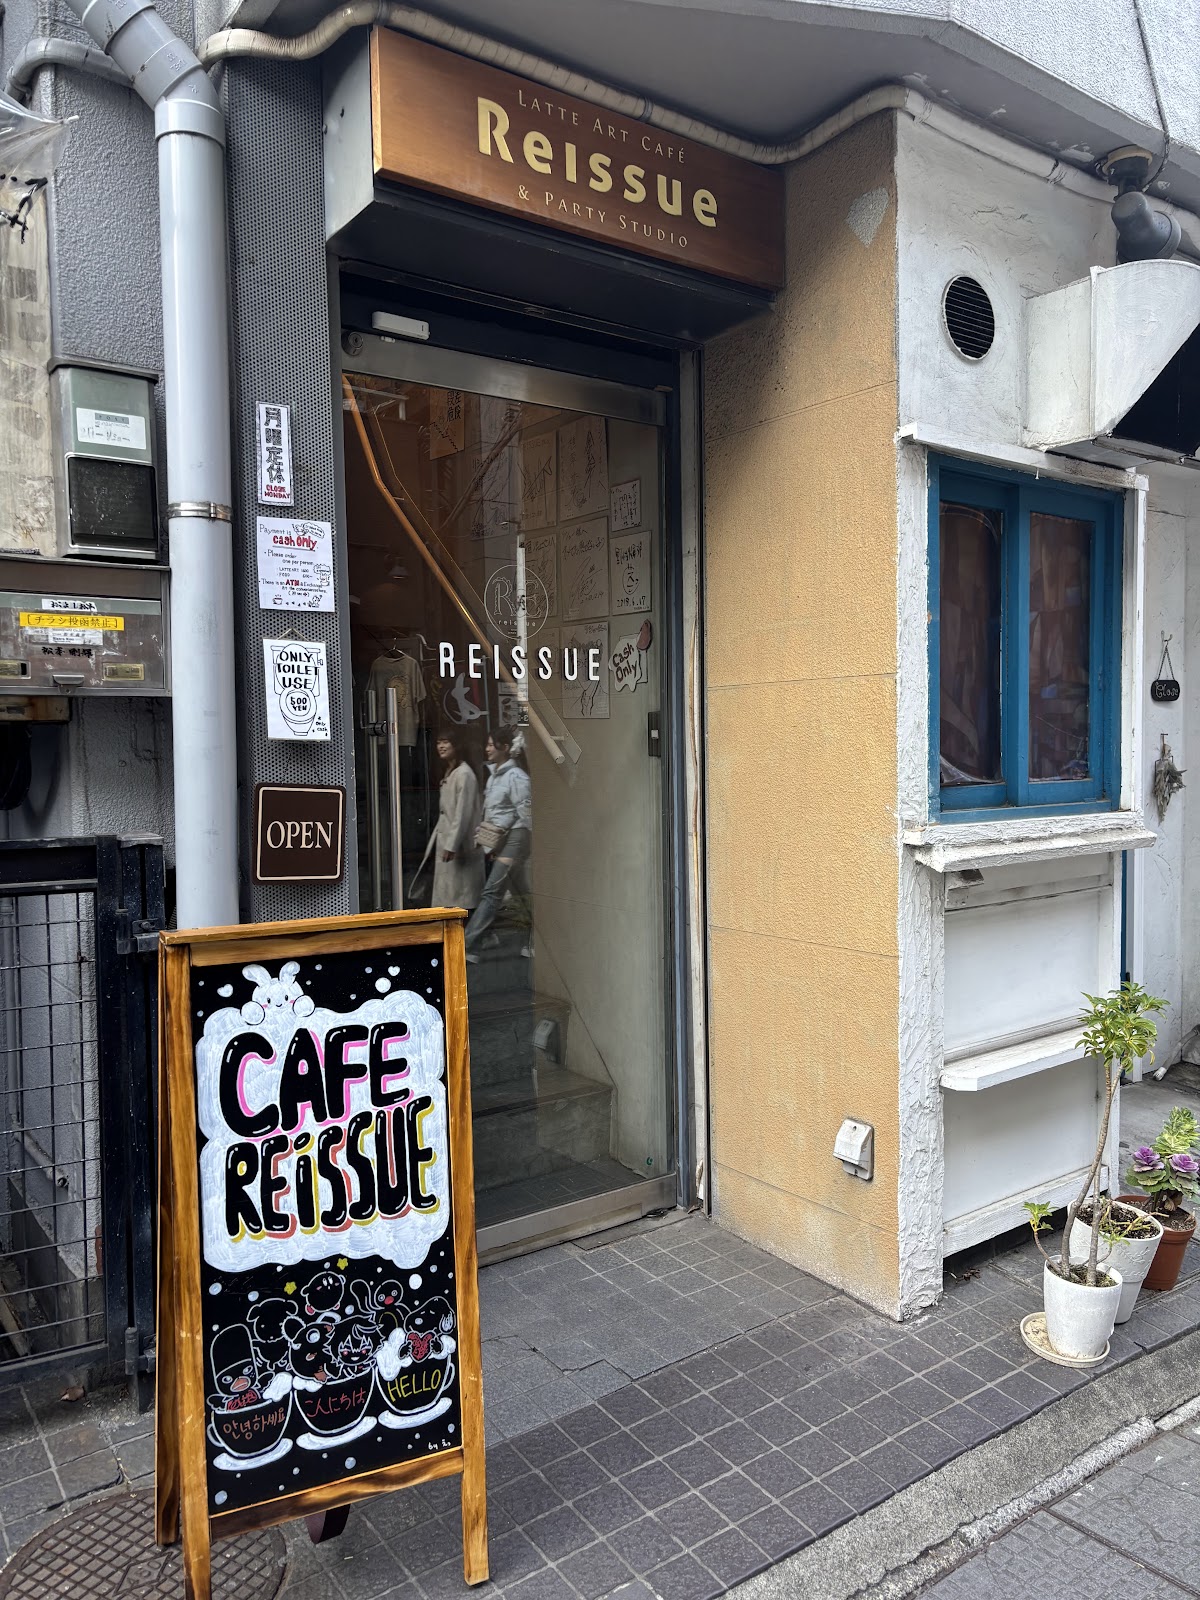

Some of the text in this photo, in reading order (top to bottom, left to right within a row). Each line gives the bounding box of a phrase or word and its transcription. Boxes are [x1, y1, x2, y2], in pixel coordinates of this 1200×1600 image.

[477, 96, 718, 228] Reissue
[518, 184, 689, 248] & PARTY STUDIO
[264, 406, 285, 484] 月曜定休
[264, 491, 290, 499] MONDAY
[259, 523, 285, 535] Payment
[277, 662, 319, 677] TOILET
[278, 650, 313, 664] ONLY
[438, 641, 600, 681] REISSUE
[612, 642, 635, 668] Cash
[282, 677, 314, 690] USE
[616, 659, 638, 683] Only
[290, 696, 307, 706] 500
[266, 820, 334, 849] OPEN
[219, 1021, 414, 1142] CAFE
[386, 1369, 442, 1403] HELLO
[304, 1388, 367, 1418] こんにちは
[222, 1406, 286, 1441] 안녕하세요
